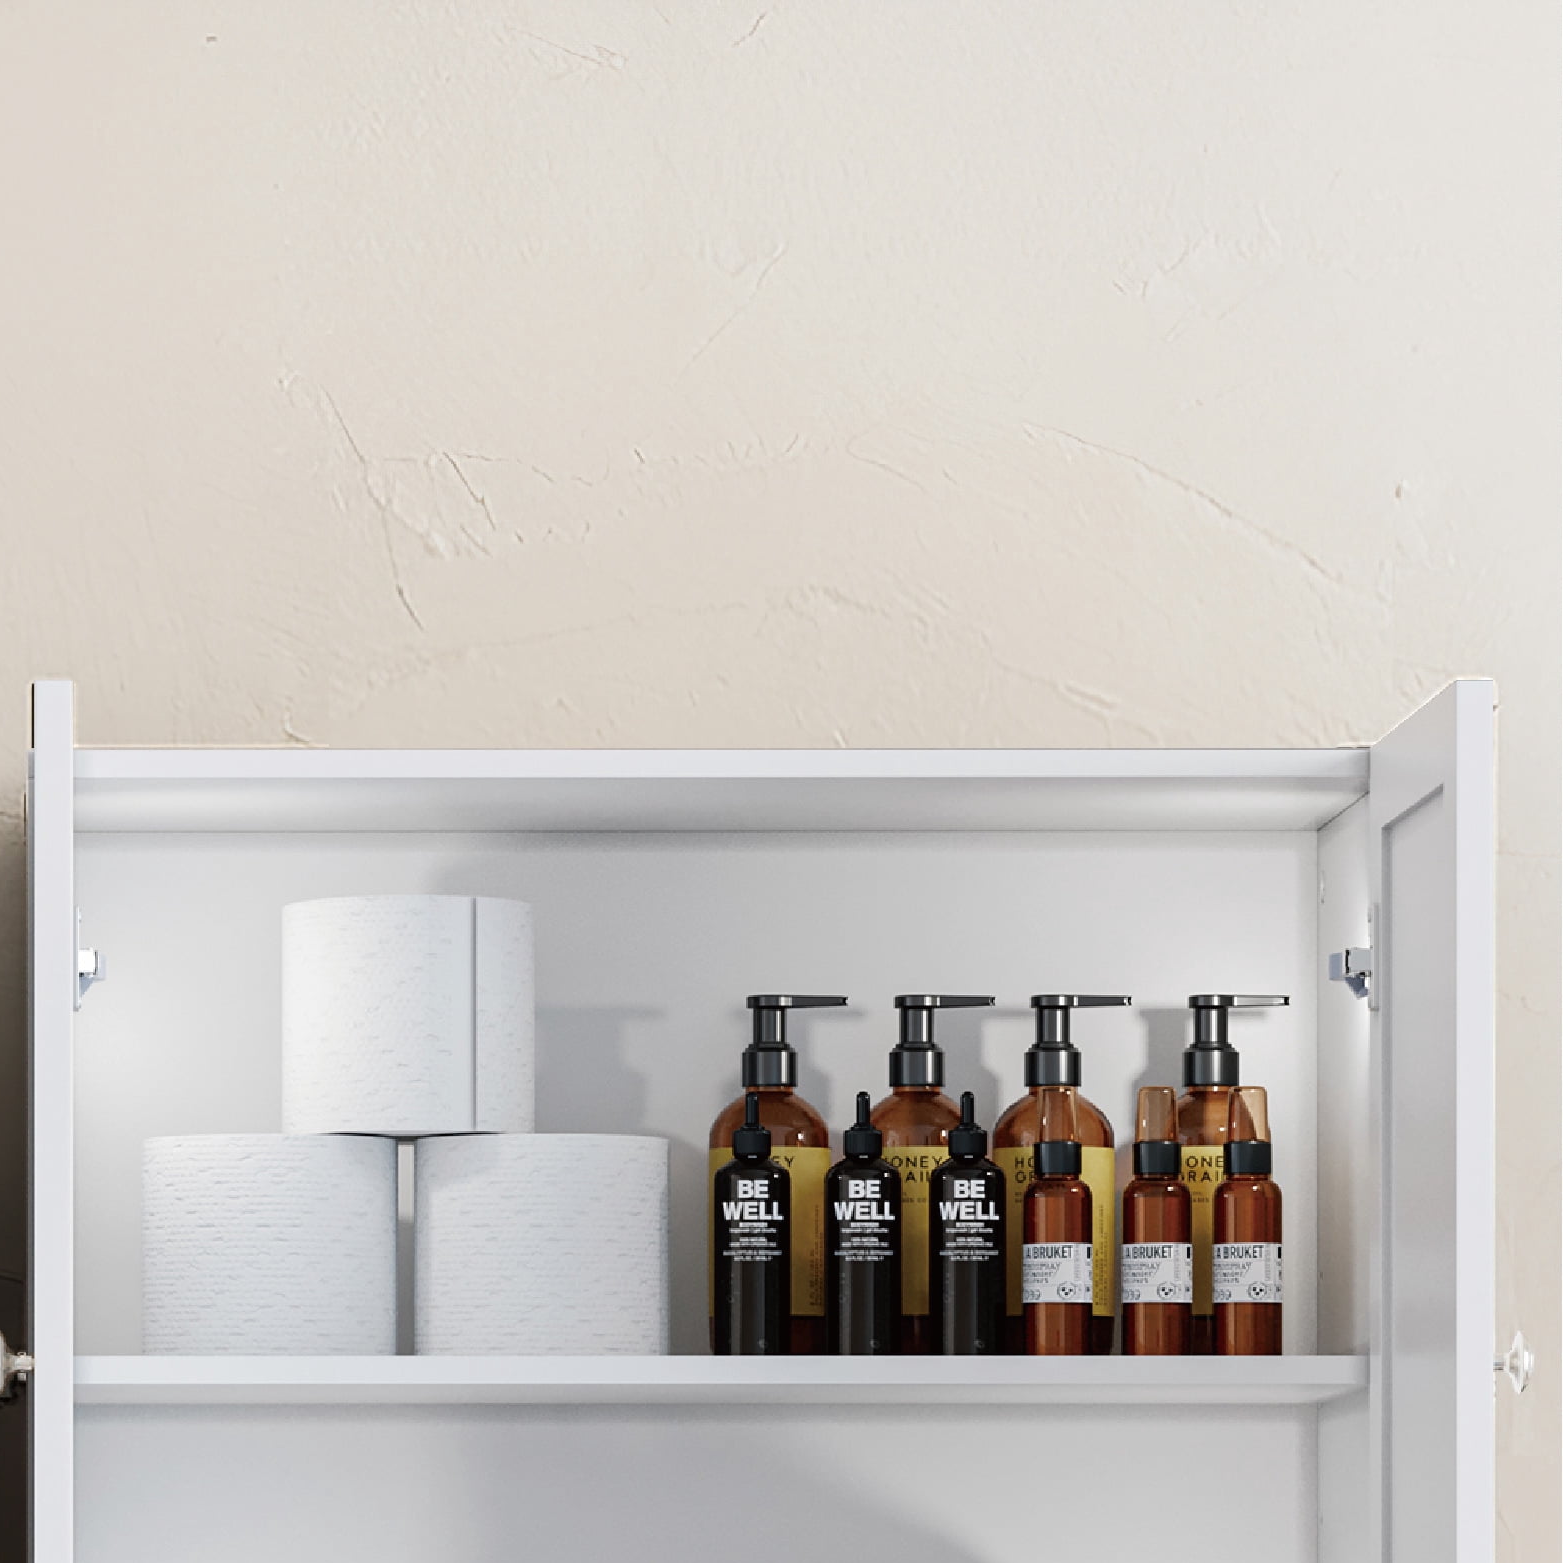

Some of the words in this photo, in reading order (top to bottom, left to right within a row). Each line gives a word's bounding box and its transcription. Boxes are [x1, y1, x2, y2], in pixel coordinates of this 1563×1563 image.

[887, 1156, 942, 1168] ONEY
[1185, 1156, 1225, 1168] ONE
[738, 1179, 769, 1199] BE
[848, 1179, 881, 1199] BE
[954, 1179, 986, 1199] BE
[722, 1201, 784, 1221] WELL
[834, 1201, 896, 1221] WELL
[939, 1201, 1000, 1221] WELL
[1032, 1245, 1073, 1259] BRUKET
[1132, 1245, 1173, 1259] BRUKET
[1223, 1245, 1264, 1259] BRUKET
